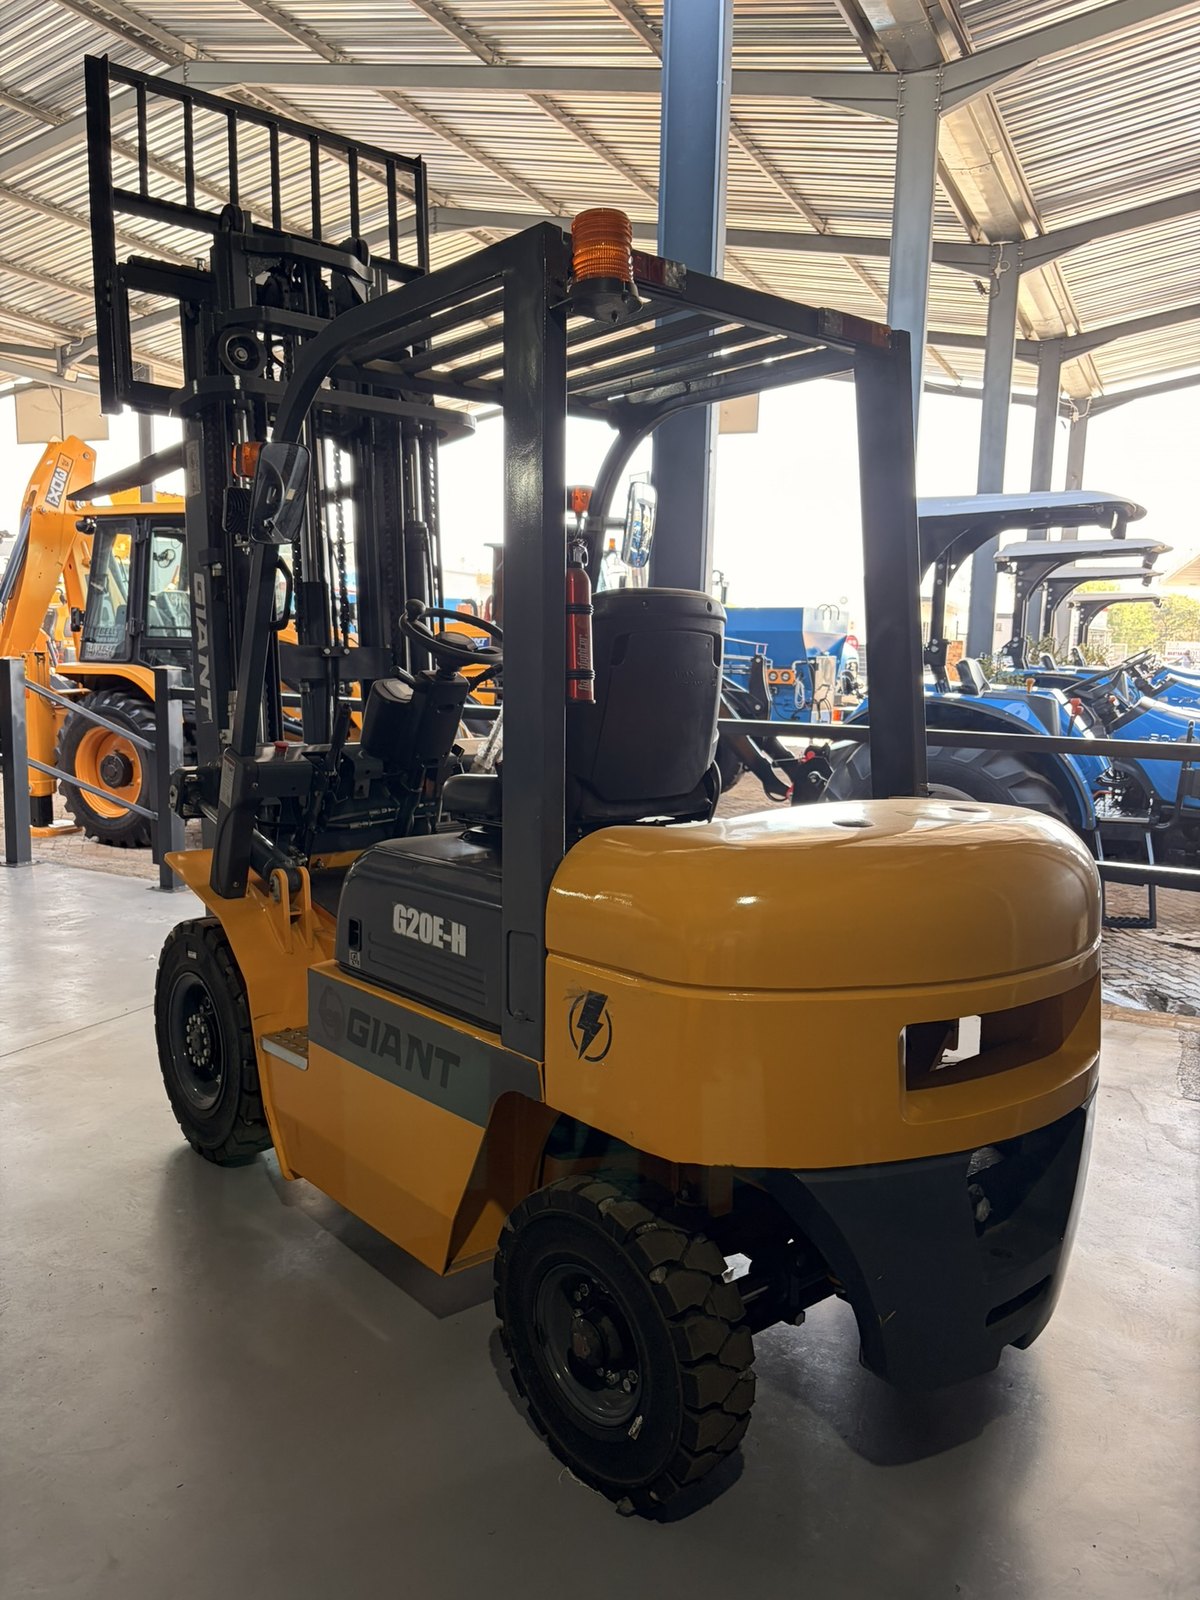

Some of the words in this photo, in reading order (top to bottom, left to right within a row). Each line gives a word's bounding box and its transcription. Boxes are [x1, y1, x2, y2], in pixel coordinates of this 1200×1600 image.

[193, 572, 213, 724] GIANT
[393, 903, 466, 957] G20E-H
[346, 1007, 461, 1089] GIANT
